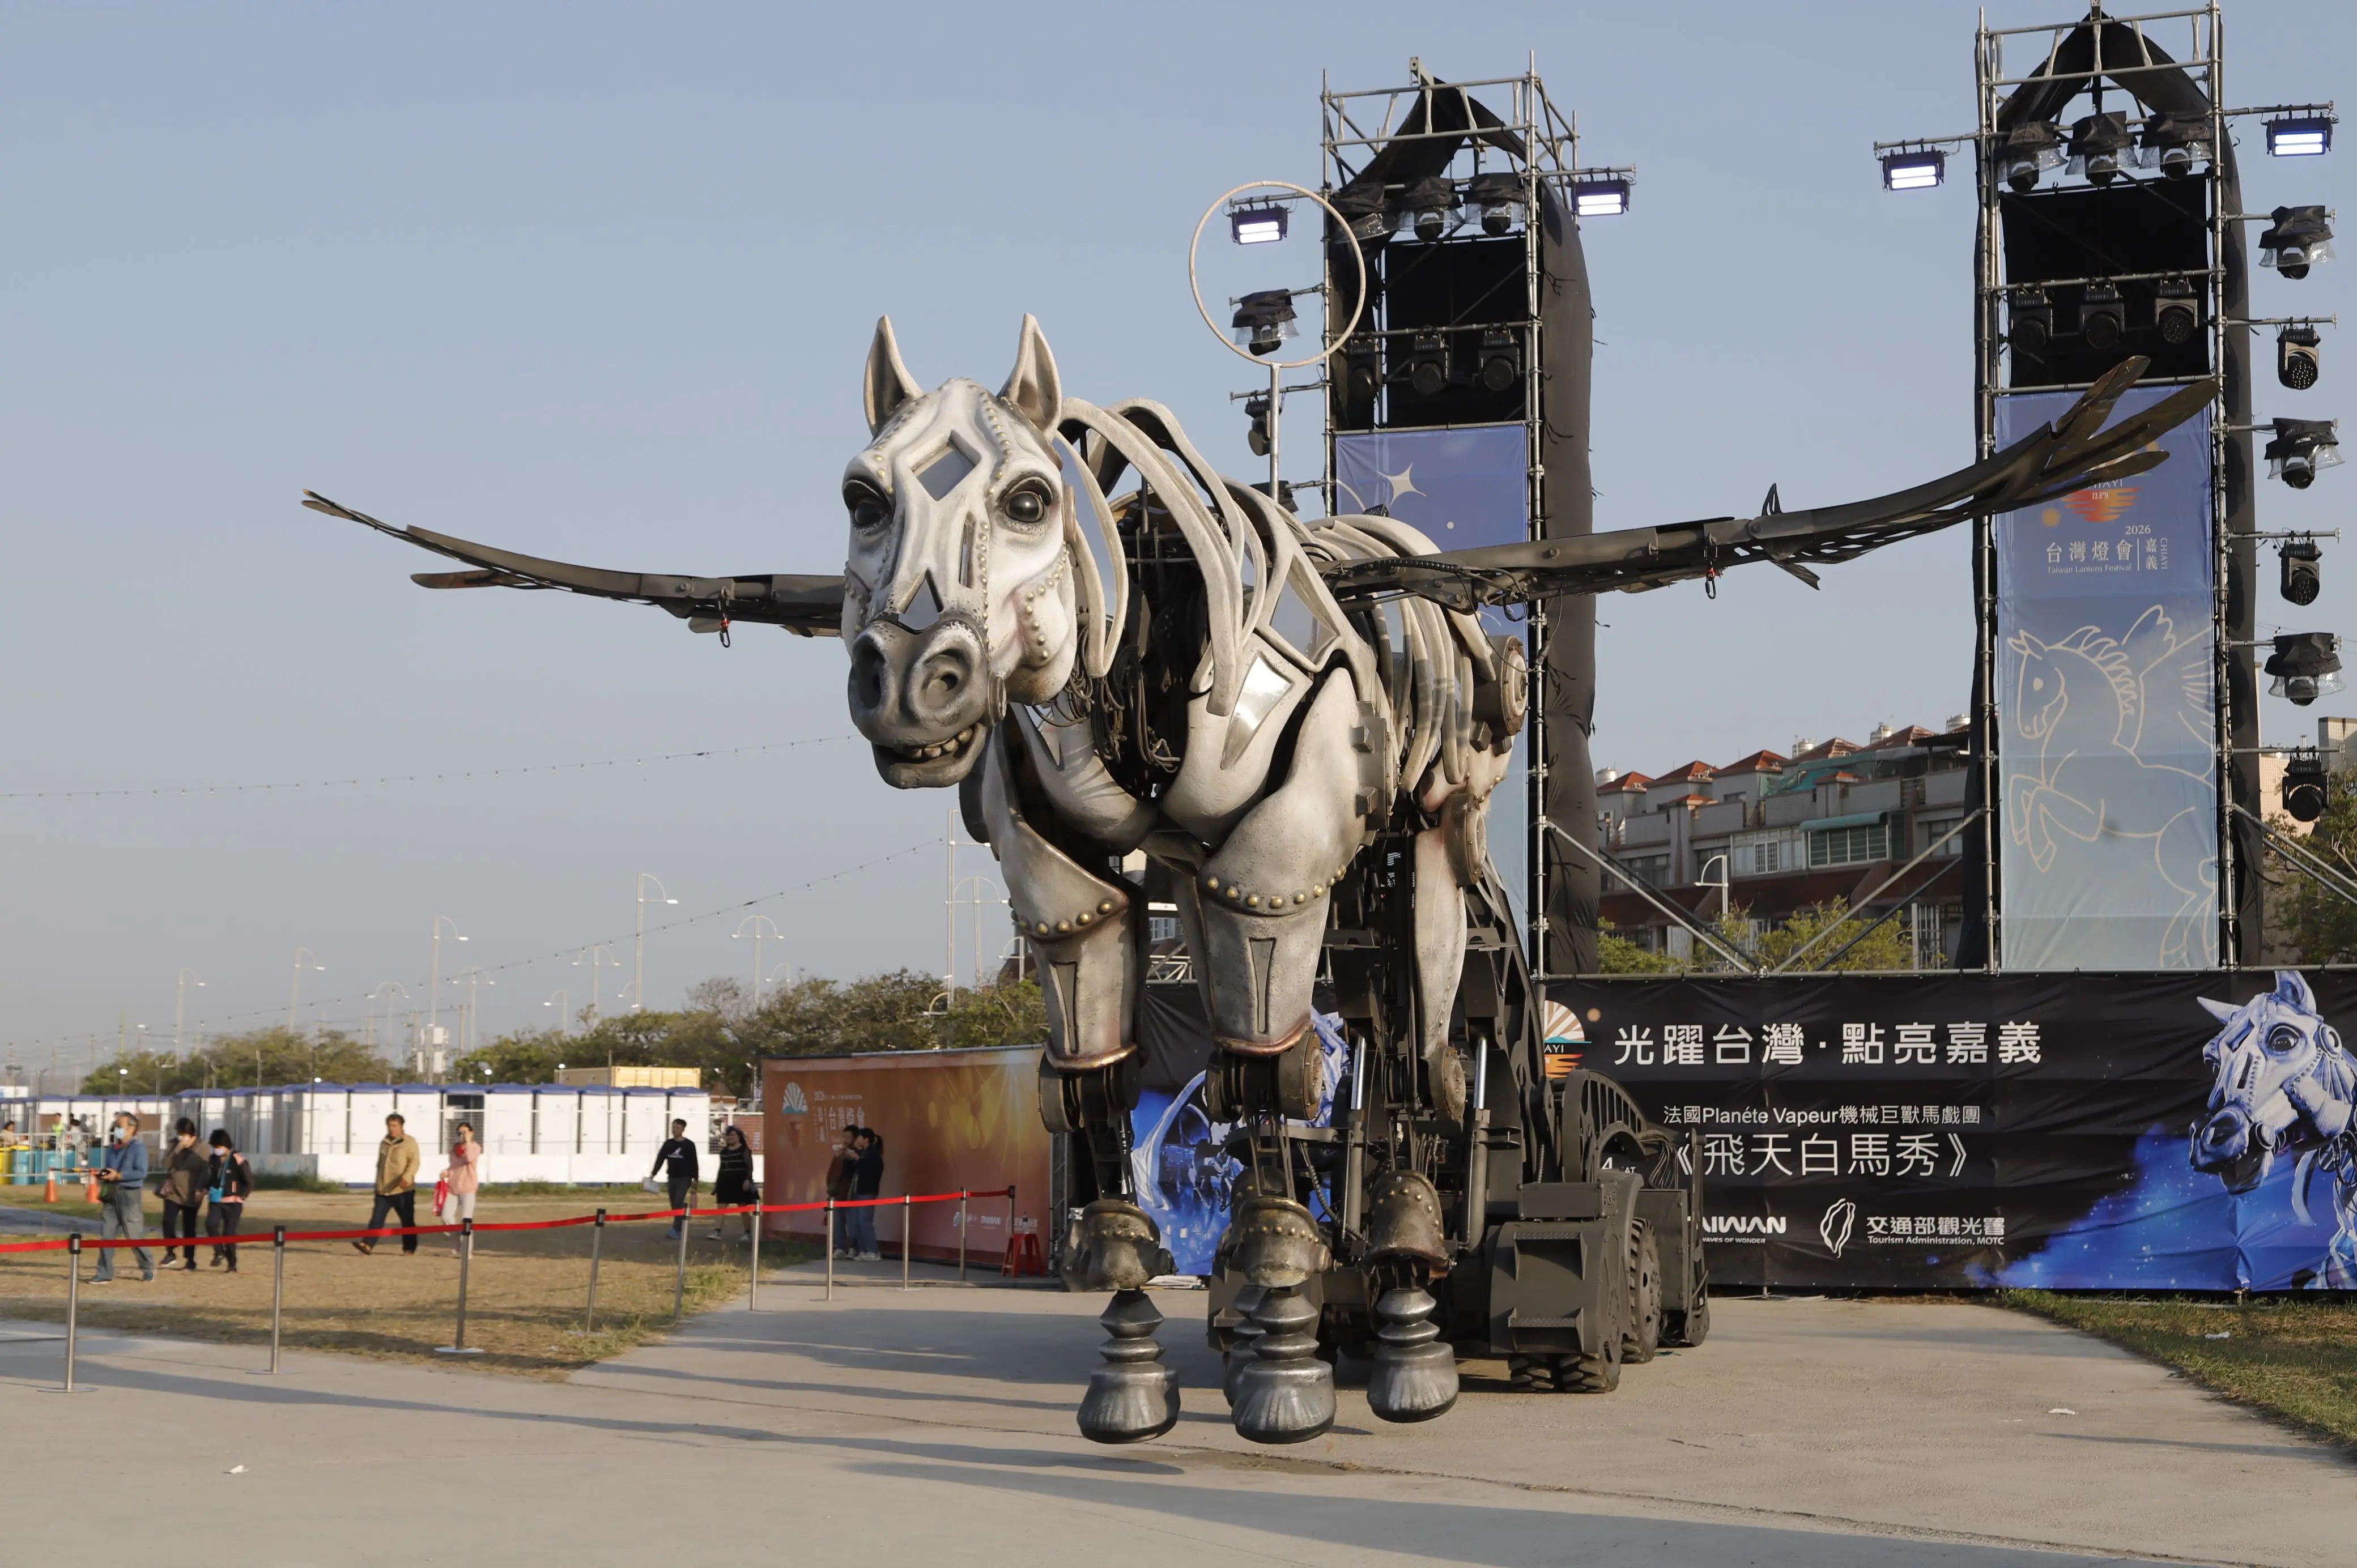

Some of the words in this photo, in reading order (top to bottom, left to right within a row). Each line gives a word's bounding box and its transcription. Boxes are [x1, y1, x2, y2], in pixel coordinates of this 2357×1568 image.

[2125, 525, 2151, 535] 2026
[2047, 539, 2133, 563] 台灣燈會
[2146, 538, 2158, 570] 嘉義
[2105, 563, 2131, 572] Festival
[1866, 1216, 2005, 1235] 交通部觀光署
[1867, 1235, 1904, 1245] Tourism
[1906, 1236, 1976, 1246] Administration,
[1977, 1237, 2005, 1246] MOTC
